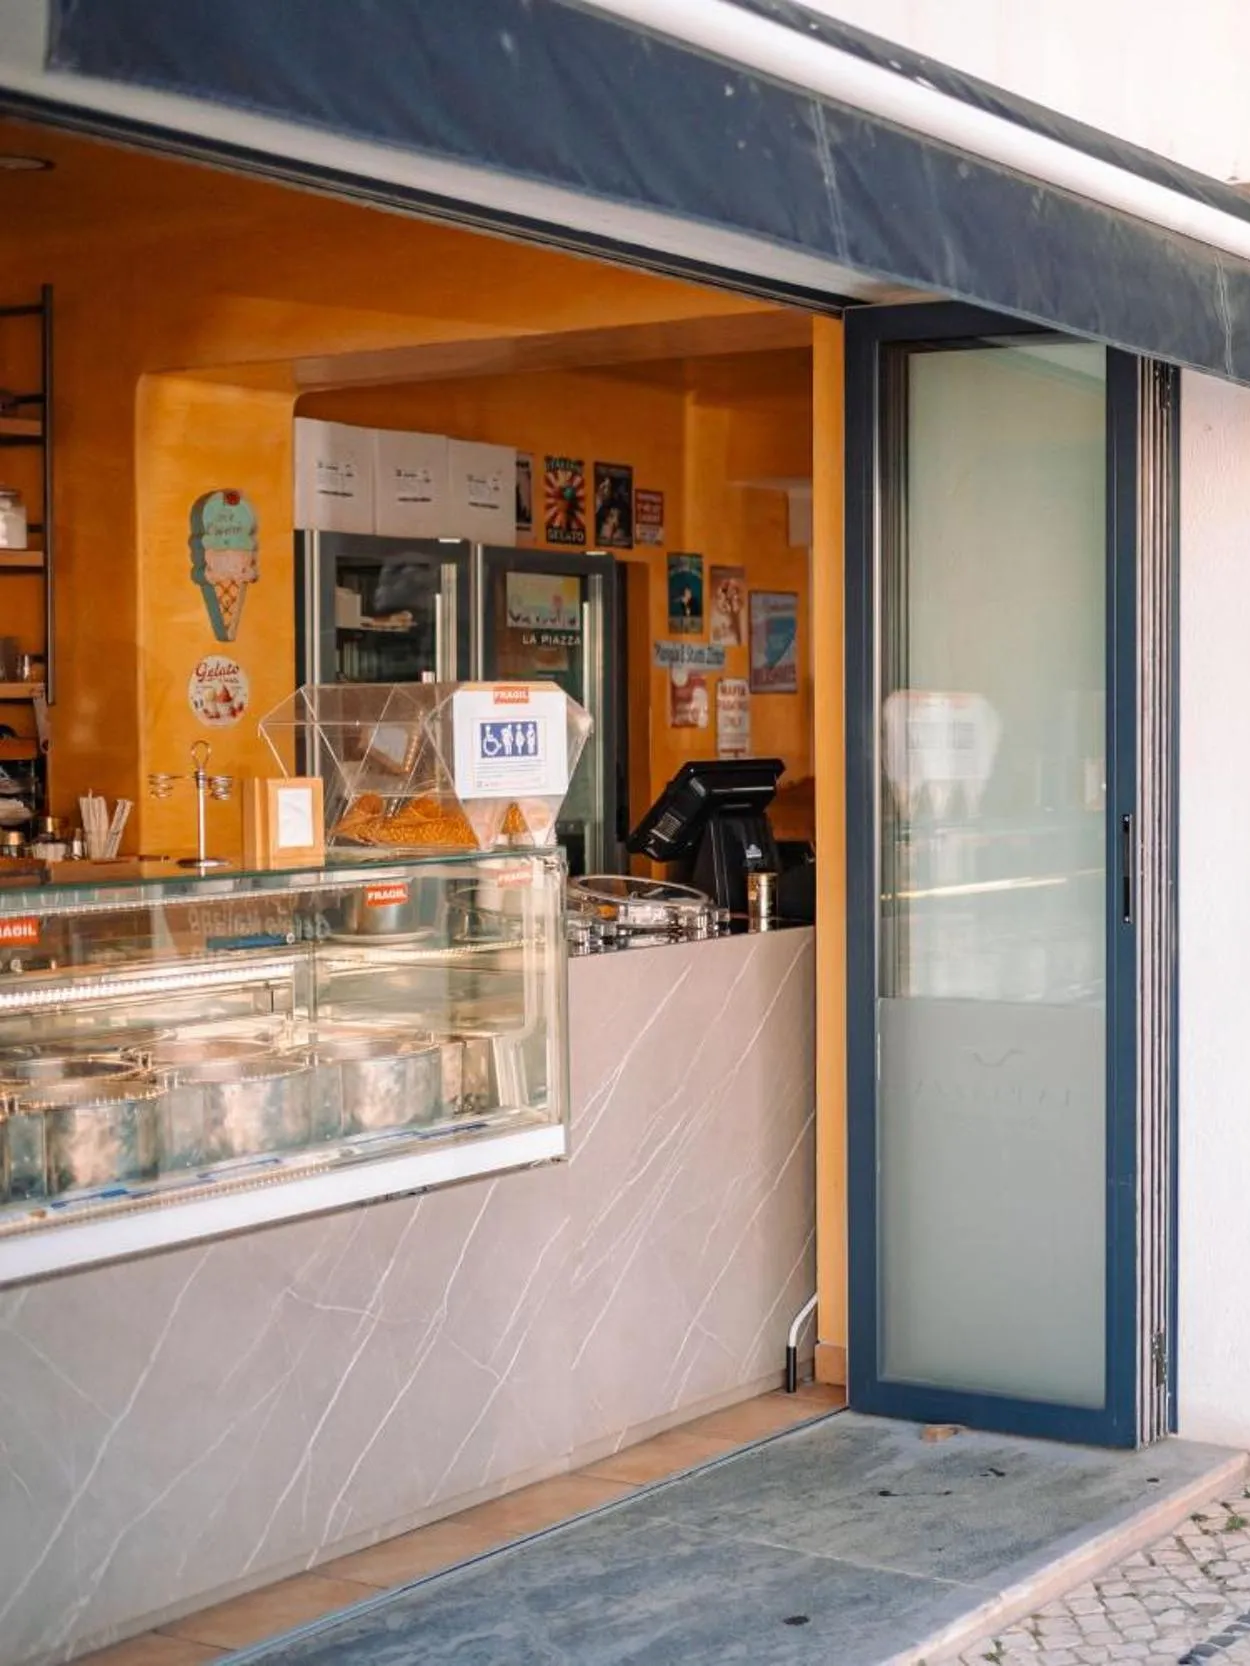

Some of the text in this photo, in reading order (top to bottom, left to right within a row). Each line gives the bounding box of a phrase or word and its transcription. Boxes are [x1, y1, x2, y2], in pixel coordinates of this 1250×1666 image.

[522, 634, 582, 646] LA PIAZZA
[195, 661, 240, 682] Gelato
[367, 888, 408, 900] FRAGIL
